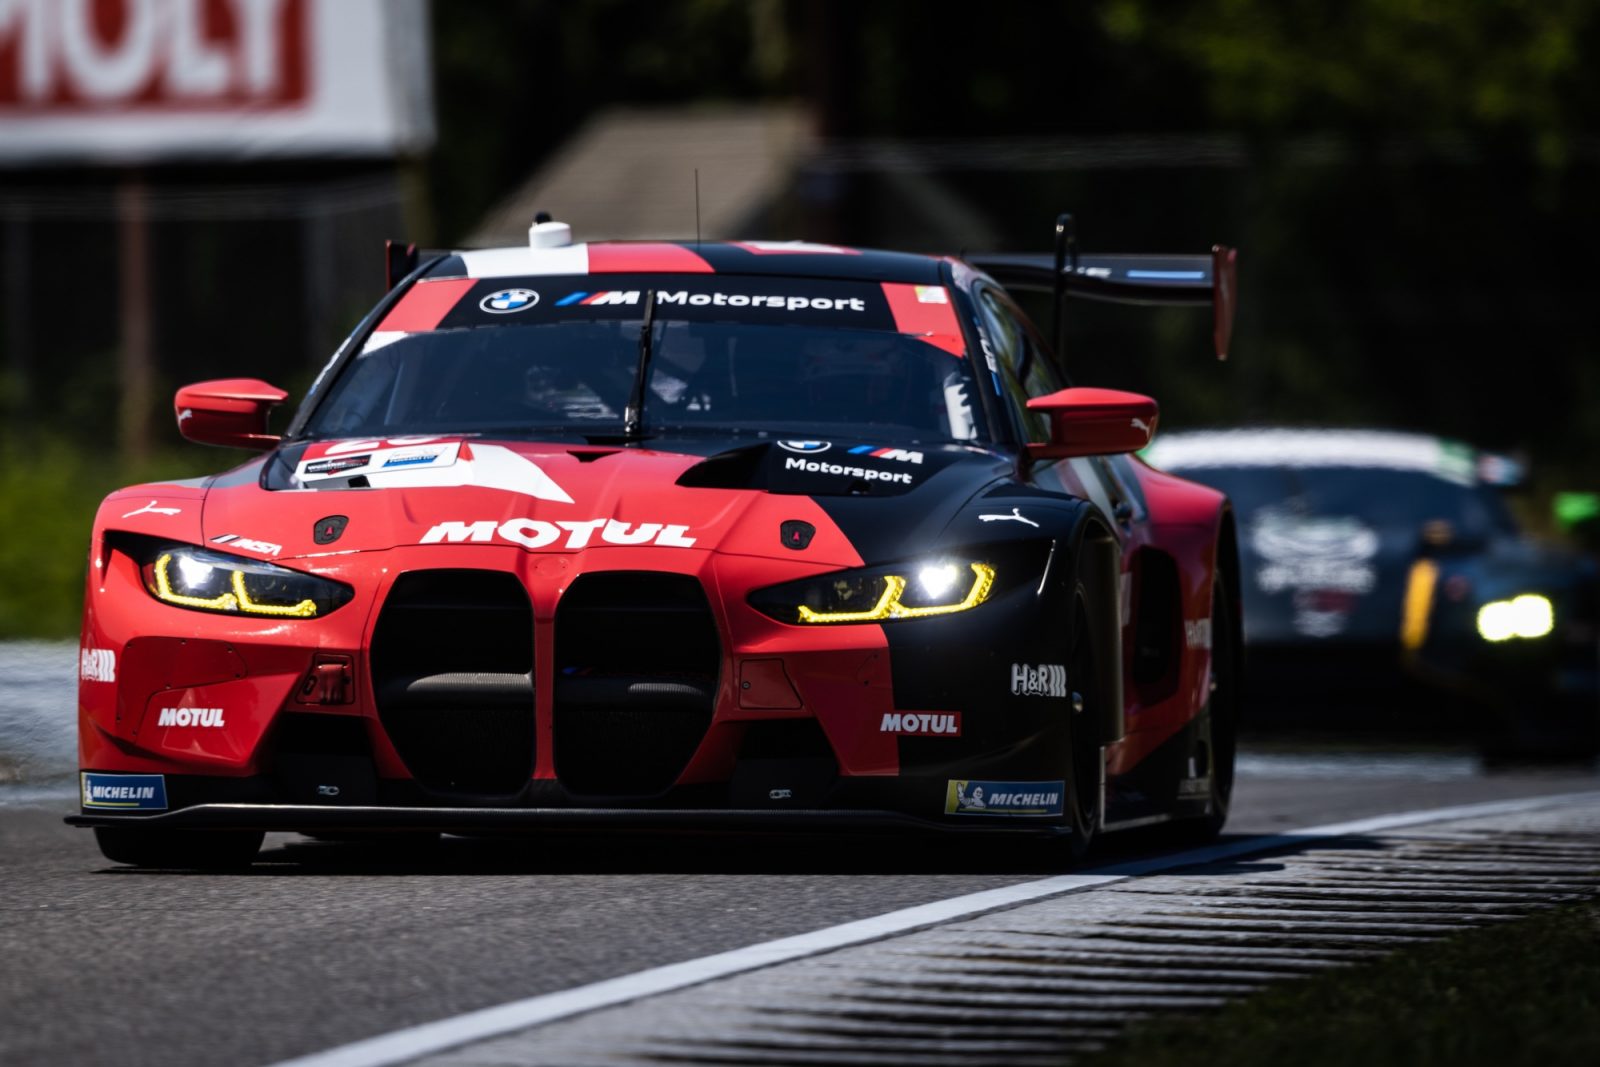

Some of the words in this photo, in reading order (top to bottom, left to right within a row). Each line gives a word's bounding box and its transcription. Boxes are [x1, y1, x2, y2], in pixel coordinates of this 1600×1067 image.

[656, 290, 865, 312] Motorsport
[785, 457, 913, 484] Motorsport
[419, 518, 697, 549] MOTUL
[1011, 663, 1051, 697] H&R
[158, 708, 225, 728] MOTUL
[880, 713, 958, 733] MOTUL
[92, 786, 155, 799] MICHELIN
[988, 792, 1059, 806] MICHELIN
